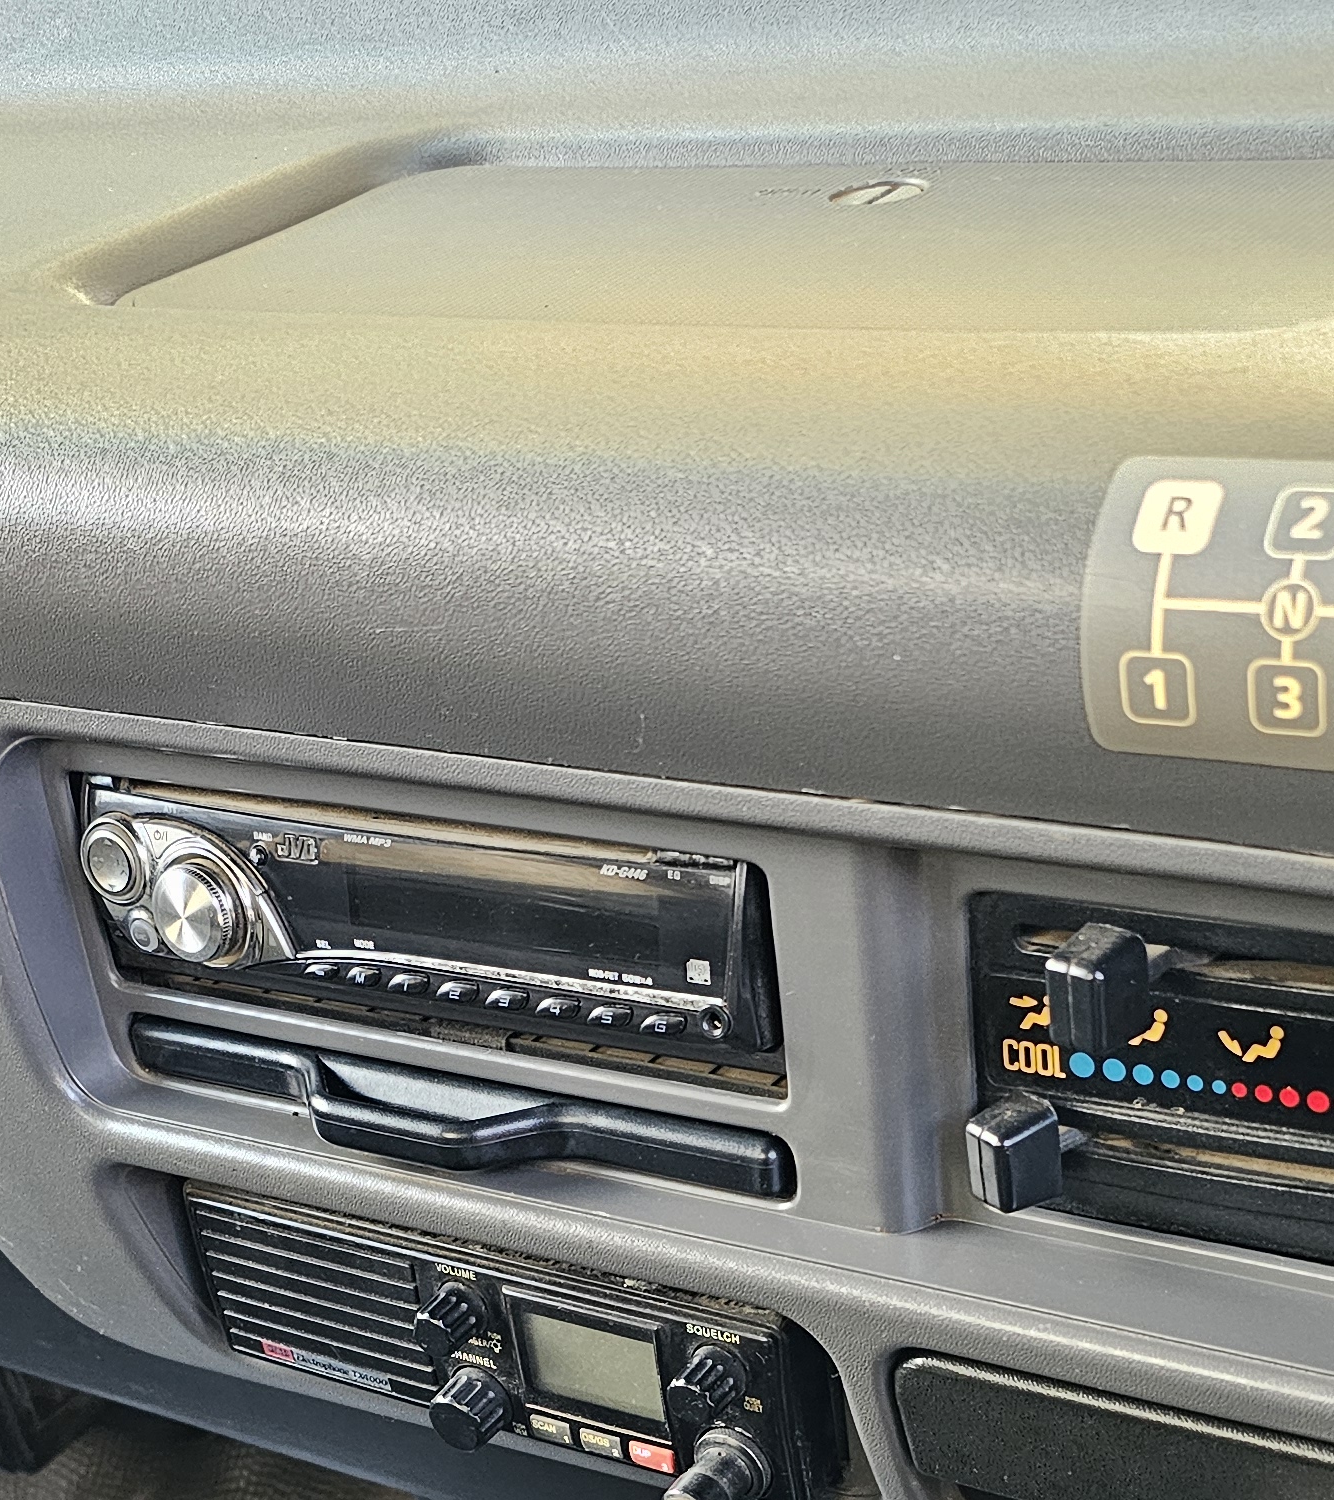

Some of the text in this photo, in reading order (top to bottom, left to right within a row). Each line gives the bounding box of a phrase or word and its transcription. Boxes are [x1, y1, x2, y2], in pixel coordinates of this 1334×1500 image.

[1161, 496, 1194, 532] R
[1289, 496, 1330, 540] 2
[1272, 590, 1309, 631] N
[1142, 669, 1169, 711] 1
[1272, 675, 1304, 720] 3
[276, 834, 319, 861] JVC
[343, 833, 393, 848] WMA MP3
[599, 863, 649, 881] KD-G446
[354, 971, 366, 984] M
[448, 989, 461, 1000] 2
[498, 996, 511, 1008] 3
[550, 1004, 561, 1017] 4
[1002, 1037, 1067, 1079] COOL
[434, 1262, 477, 1281] VOLUME
[685, 1322, 741, 1345] SQUELCH
[531, 1419, 557, 1435] SCAN
[563, 1435, 570, 1444] 1
[581, 1433, 611, 1448] OS/GS
[633, 1447, 652, 1460] DUP
